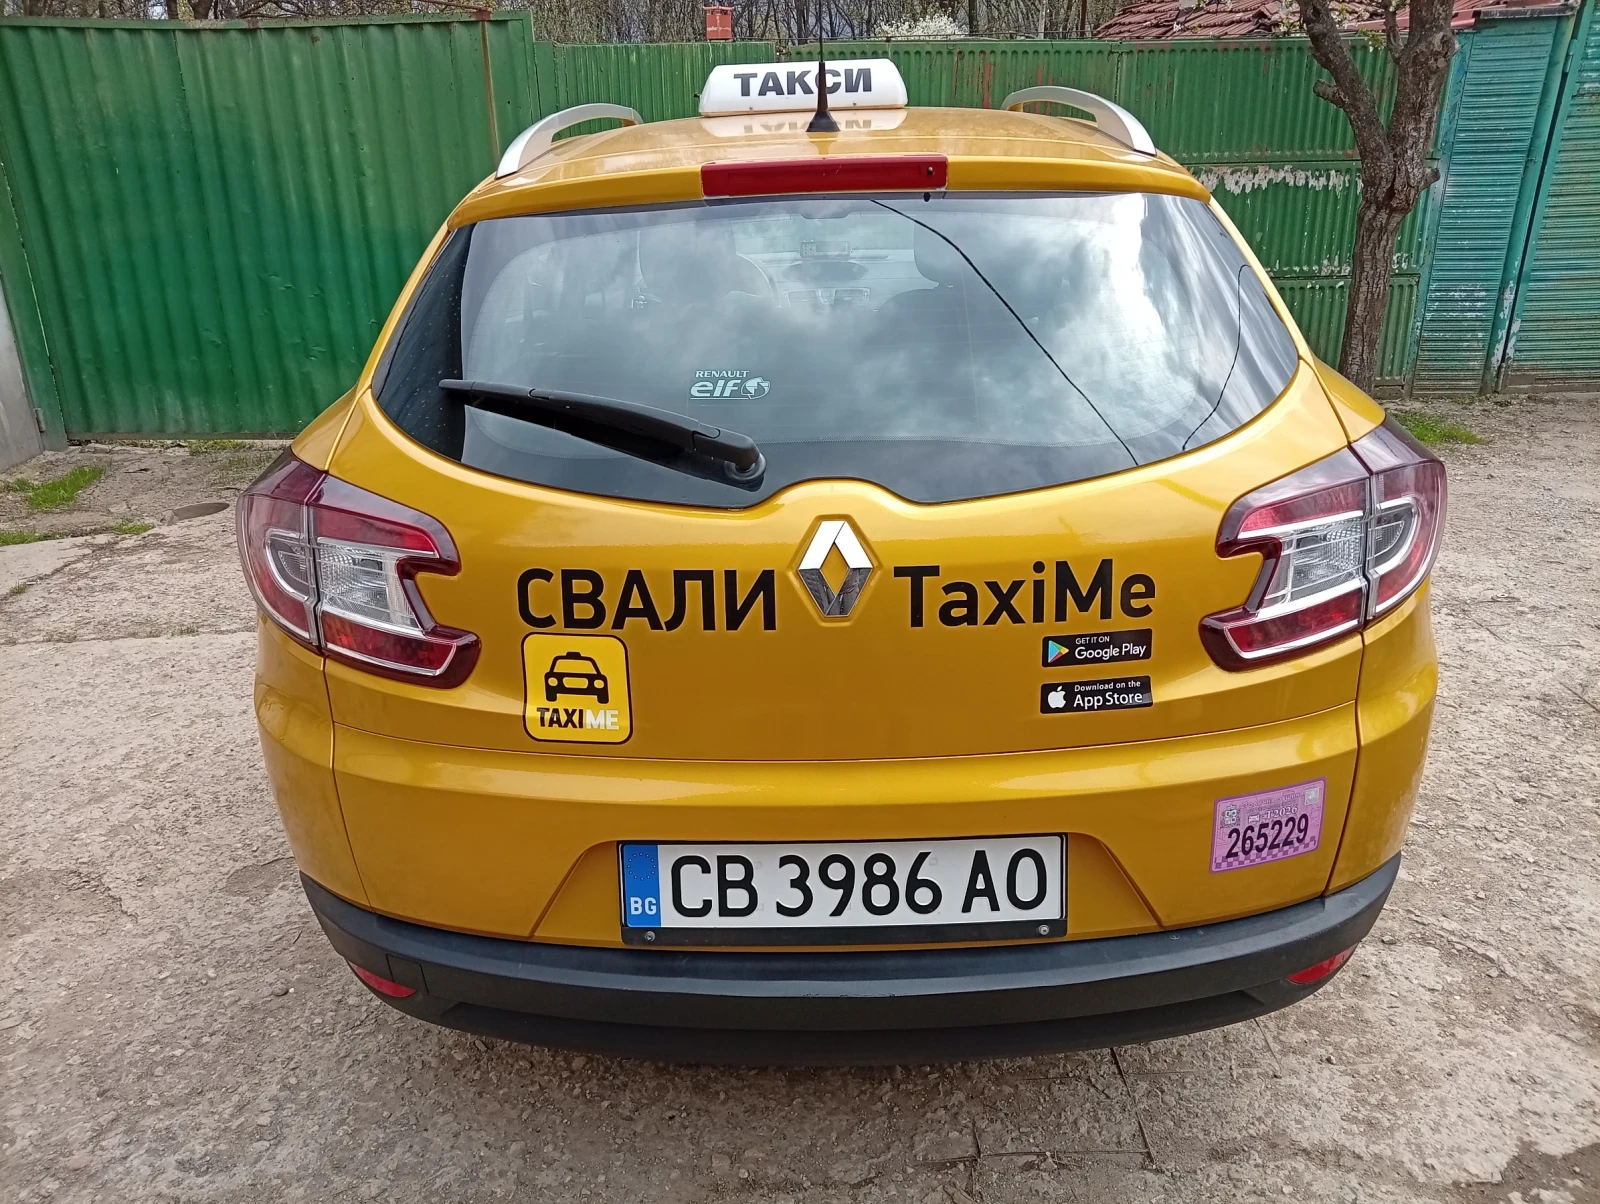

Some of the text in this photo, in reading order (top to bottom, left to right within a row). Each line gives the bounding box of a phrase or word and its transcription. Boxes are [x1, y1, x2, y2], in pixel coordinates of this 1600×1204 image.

[733, 68, 872, 97] ТАКСИ
[695, 370, 750, 378] RENAULT
[690, 379, 742, 397] elf
[517, 568, 776, 632] СВАЛИ
[894, 558, 1156, 628] TaxiMe
[1075, 637, 1090, 645] GET
[1098, 635, 1110, 643] ON
[1075, 642, 1147, 661] Google Play
[1074, 680, 1141, 692] Download on the
[1073, 690, 1143, 710] App Store
[1225, 813, 1309, 859] 265229
[776, 851, 943, 917] 3986
[629, 896, 658, 916] BG
